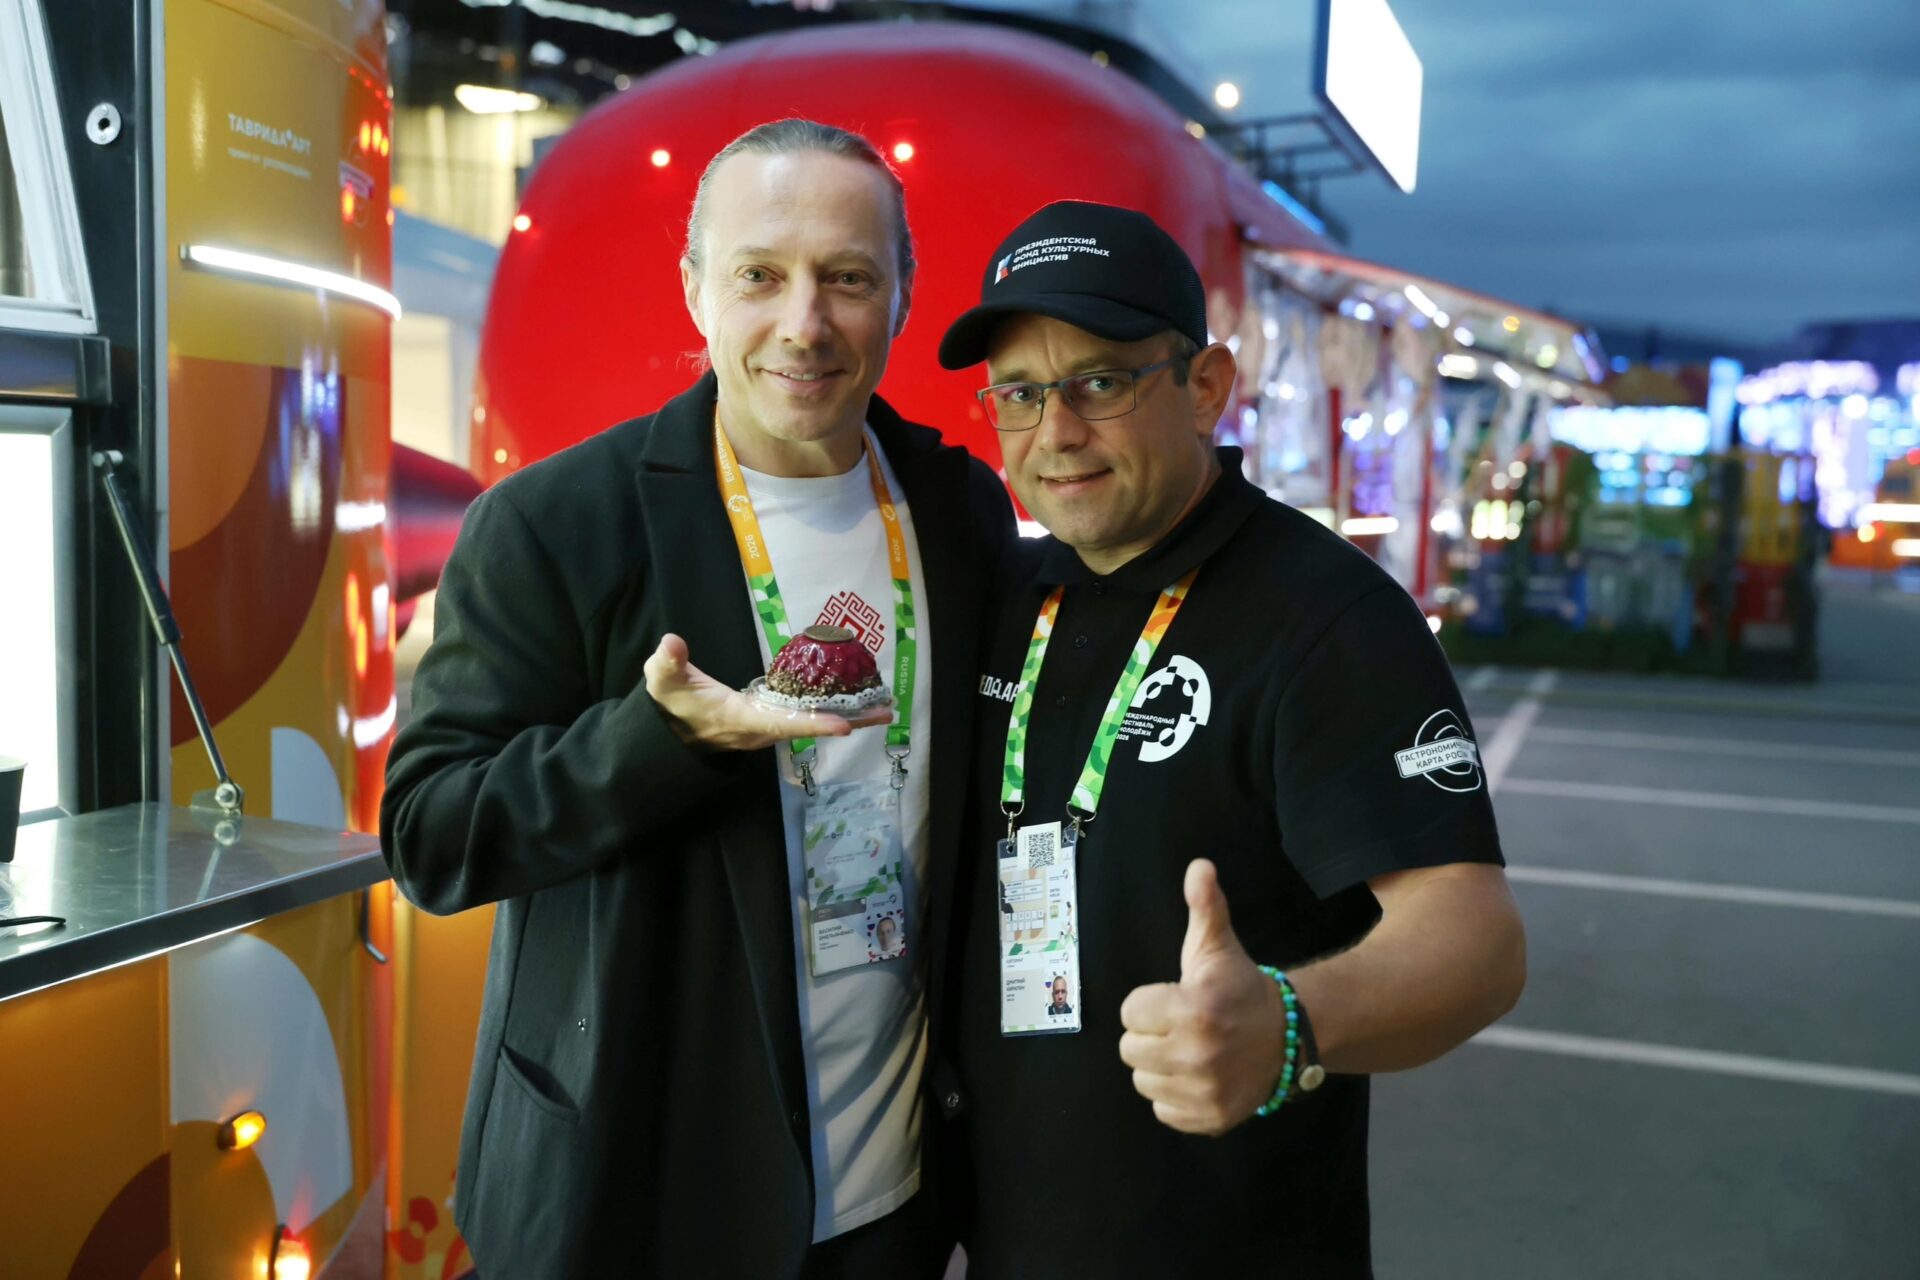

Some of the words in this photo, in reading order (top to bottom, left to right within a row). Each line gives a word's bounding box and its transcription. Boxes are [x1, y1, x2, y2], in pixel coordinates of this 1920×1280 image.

[1013, 249, 1039, 263] ФОНД
[1041, 245, 1110, 257] КУЛЬТУРНЫХ
[1015, 237, 1097, 256] ПРЕЗИДЕНТСКИЙ
[1012, 254, 1069, 272] ИНИЦИАТИВ
[745, 534, 760, 559] 2026
[899, 656, 909, 696] RUSSIA
[1416, 756, 1443, 769] КАРТА
